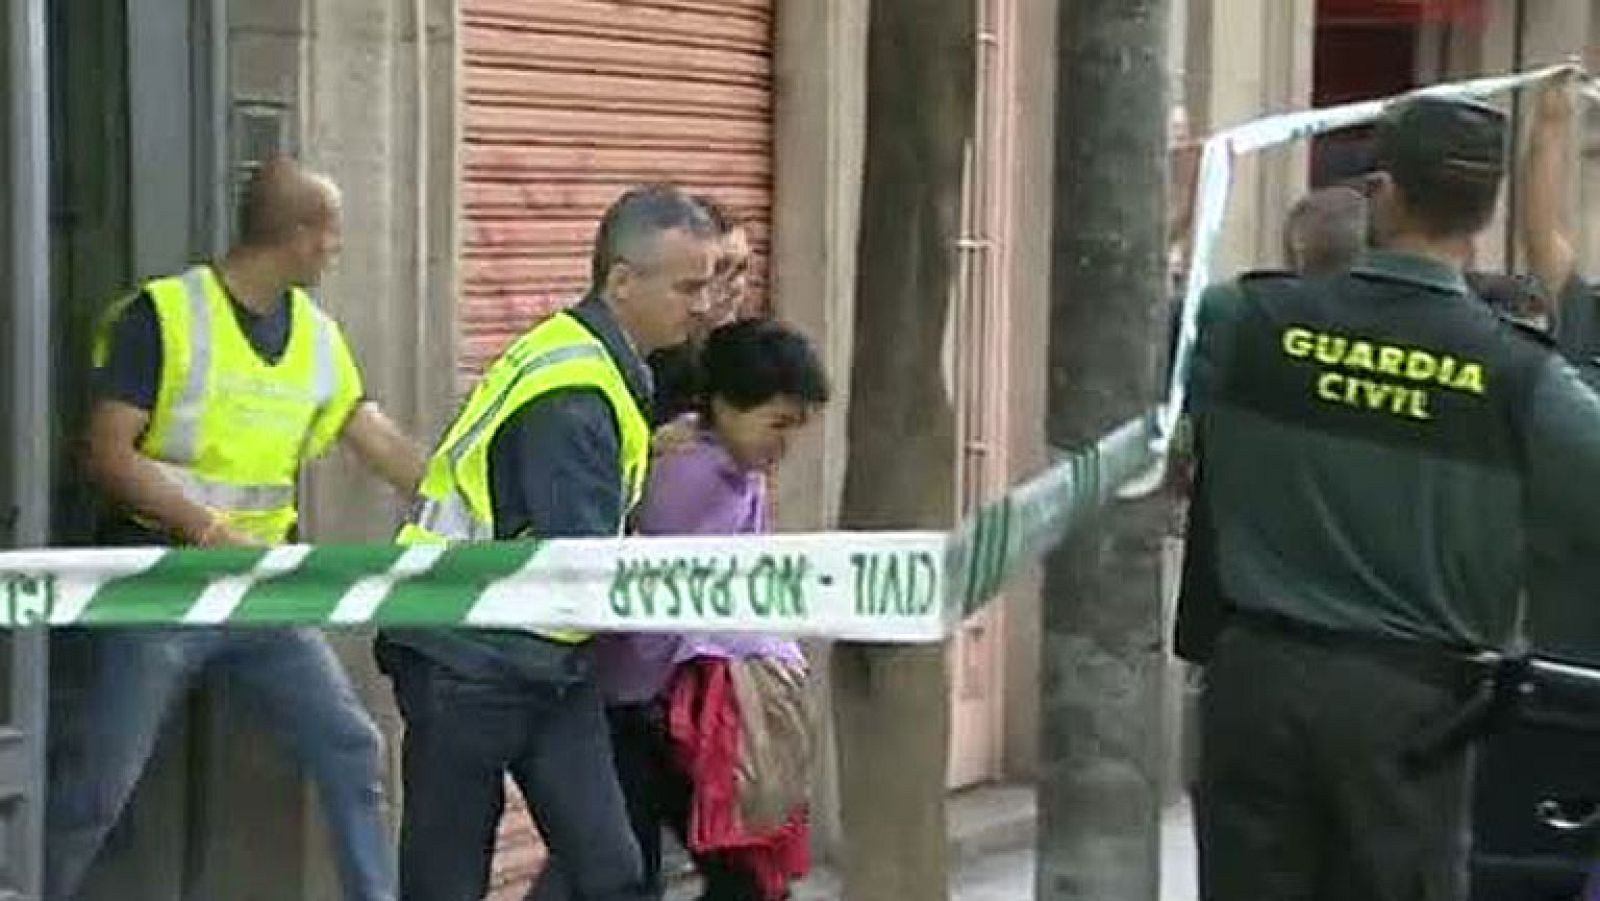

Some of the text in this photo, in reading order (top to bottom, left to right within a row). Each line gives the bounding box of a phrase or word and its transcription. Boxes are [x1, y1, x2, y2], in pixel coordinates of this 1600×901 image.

[1283, 328, 1484, 392] GUARDIA
[1318, 373, 1430, 419] CIVIL
[609, 555, 738, 616] PASAR
[749, 552, 805, 617] NO
[850, 551, 936, 616] CIVIL
